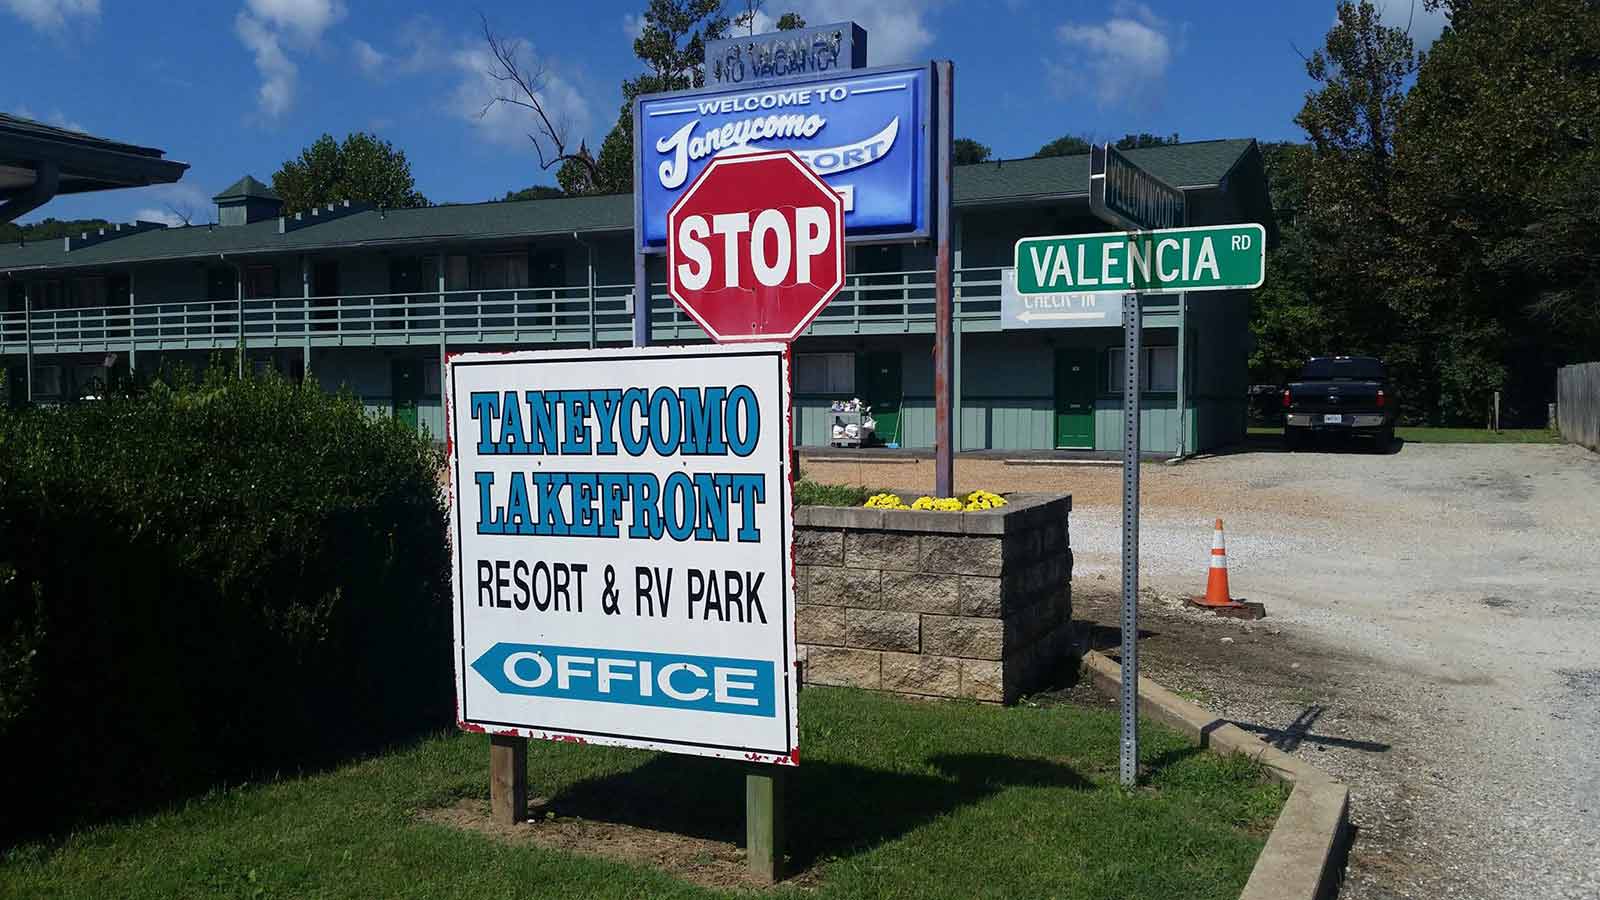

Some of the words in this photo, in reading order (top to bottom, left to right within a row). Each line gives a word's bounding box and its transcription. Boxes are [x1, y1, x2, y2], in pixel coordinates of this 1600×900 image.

[697, 90, 811, 116] WELCOME
[819, 87, 848, 102] TO
[678, 206, 831, 291] STOP
[1030, 237, 1220, 287] VALENCIA
[1231, 235, 1251, 251] RD
[470, 385, 760, 457] TANEYCOMO
[474, 471, 766, 543] LAKEFRONT
[477, 559, 588, 613] RESORT
[601, 564, 621, 616] &
[635, 566, 673, 618] RV
[687, 568, 768, 625] PARK
[503, 651, 760, 706] OFFICE
